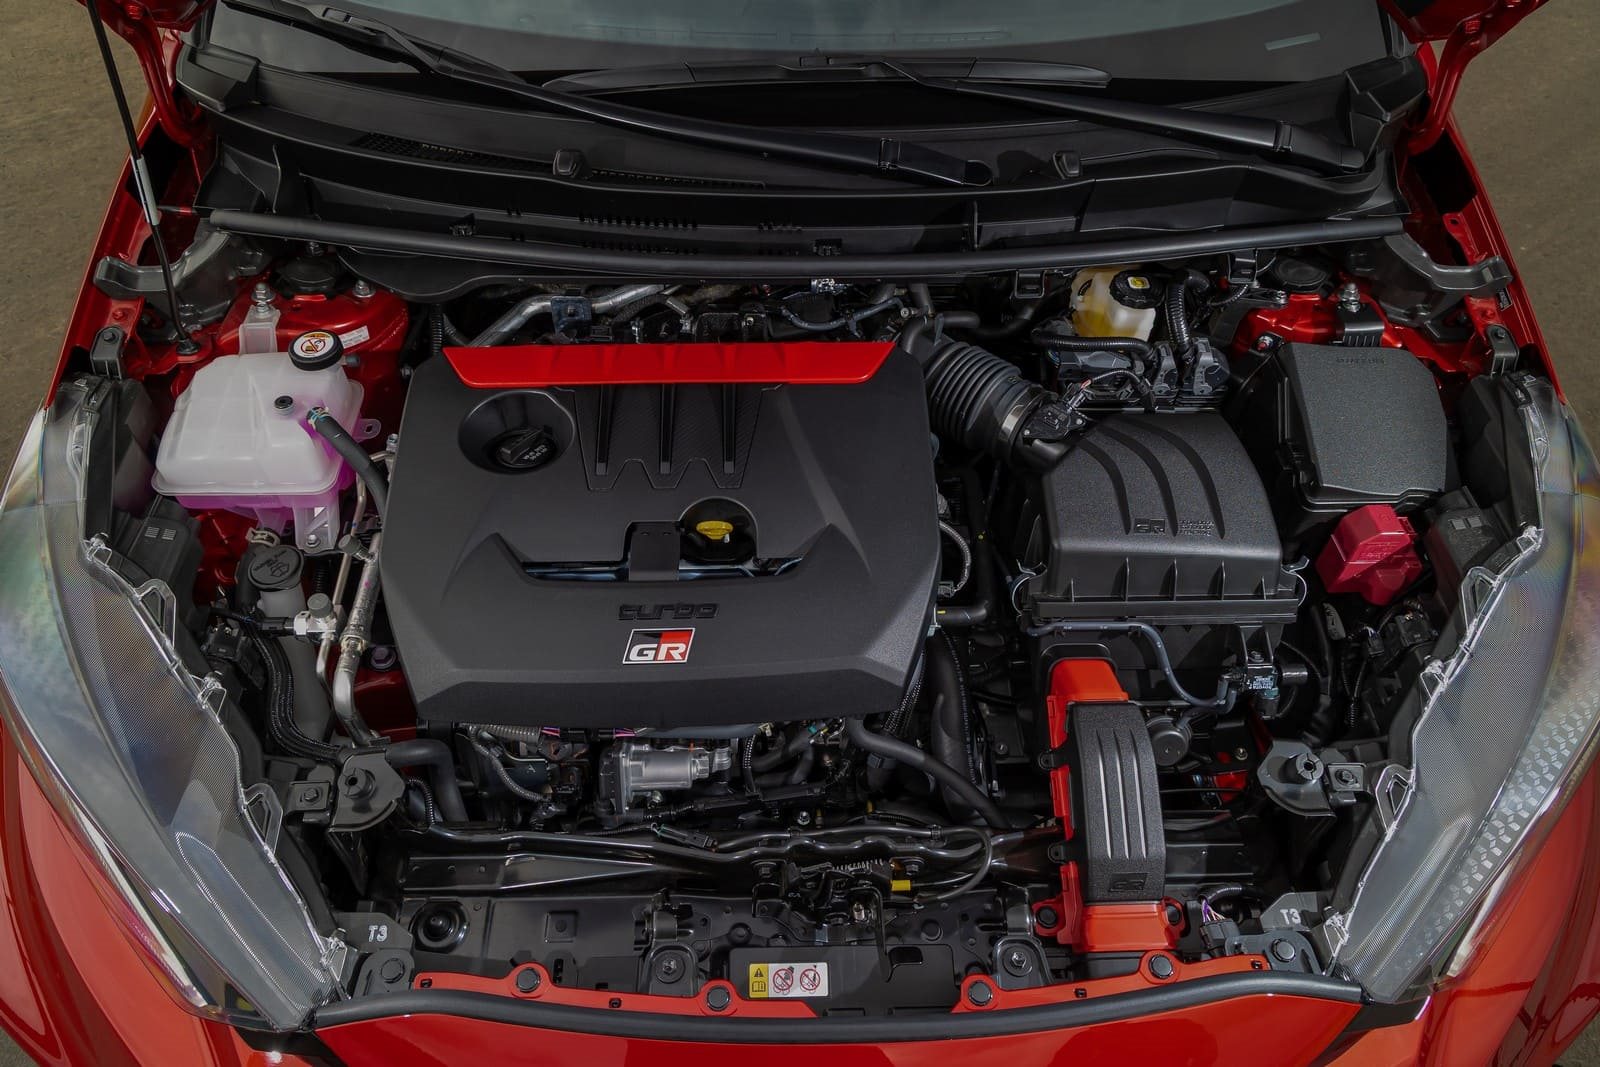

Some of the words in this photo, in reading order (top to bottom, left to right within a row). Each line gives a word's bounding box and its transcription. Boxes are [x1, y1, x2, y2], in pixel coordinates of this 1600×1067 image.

[617, 603, 719, 620] turbo
[629, 643, 687, 660] GR
[1280, 908, 1302, 925] T3
[368, 925, 388, 942] T3
